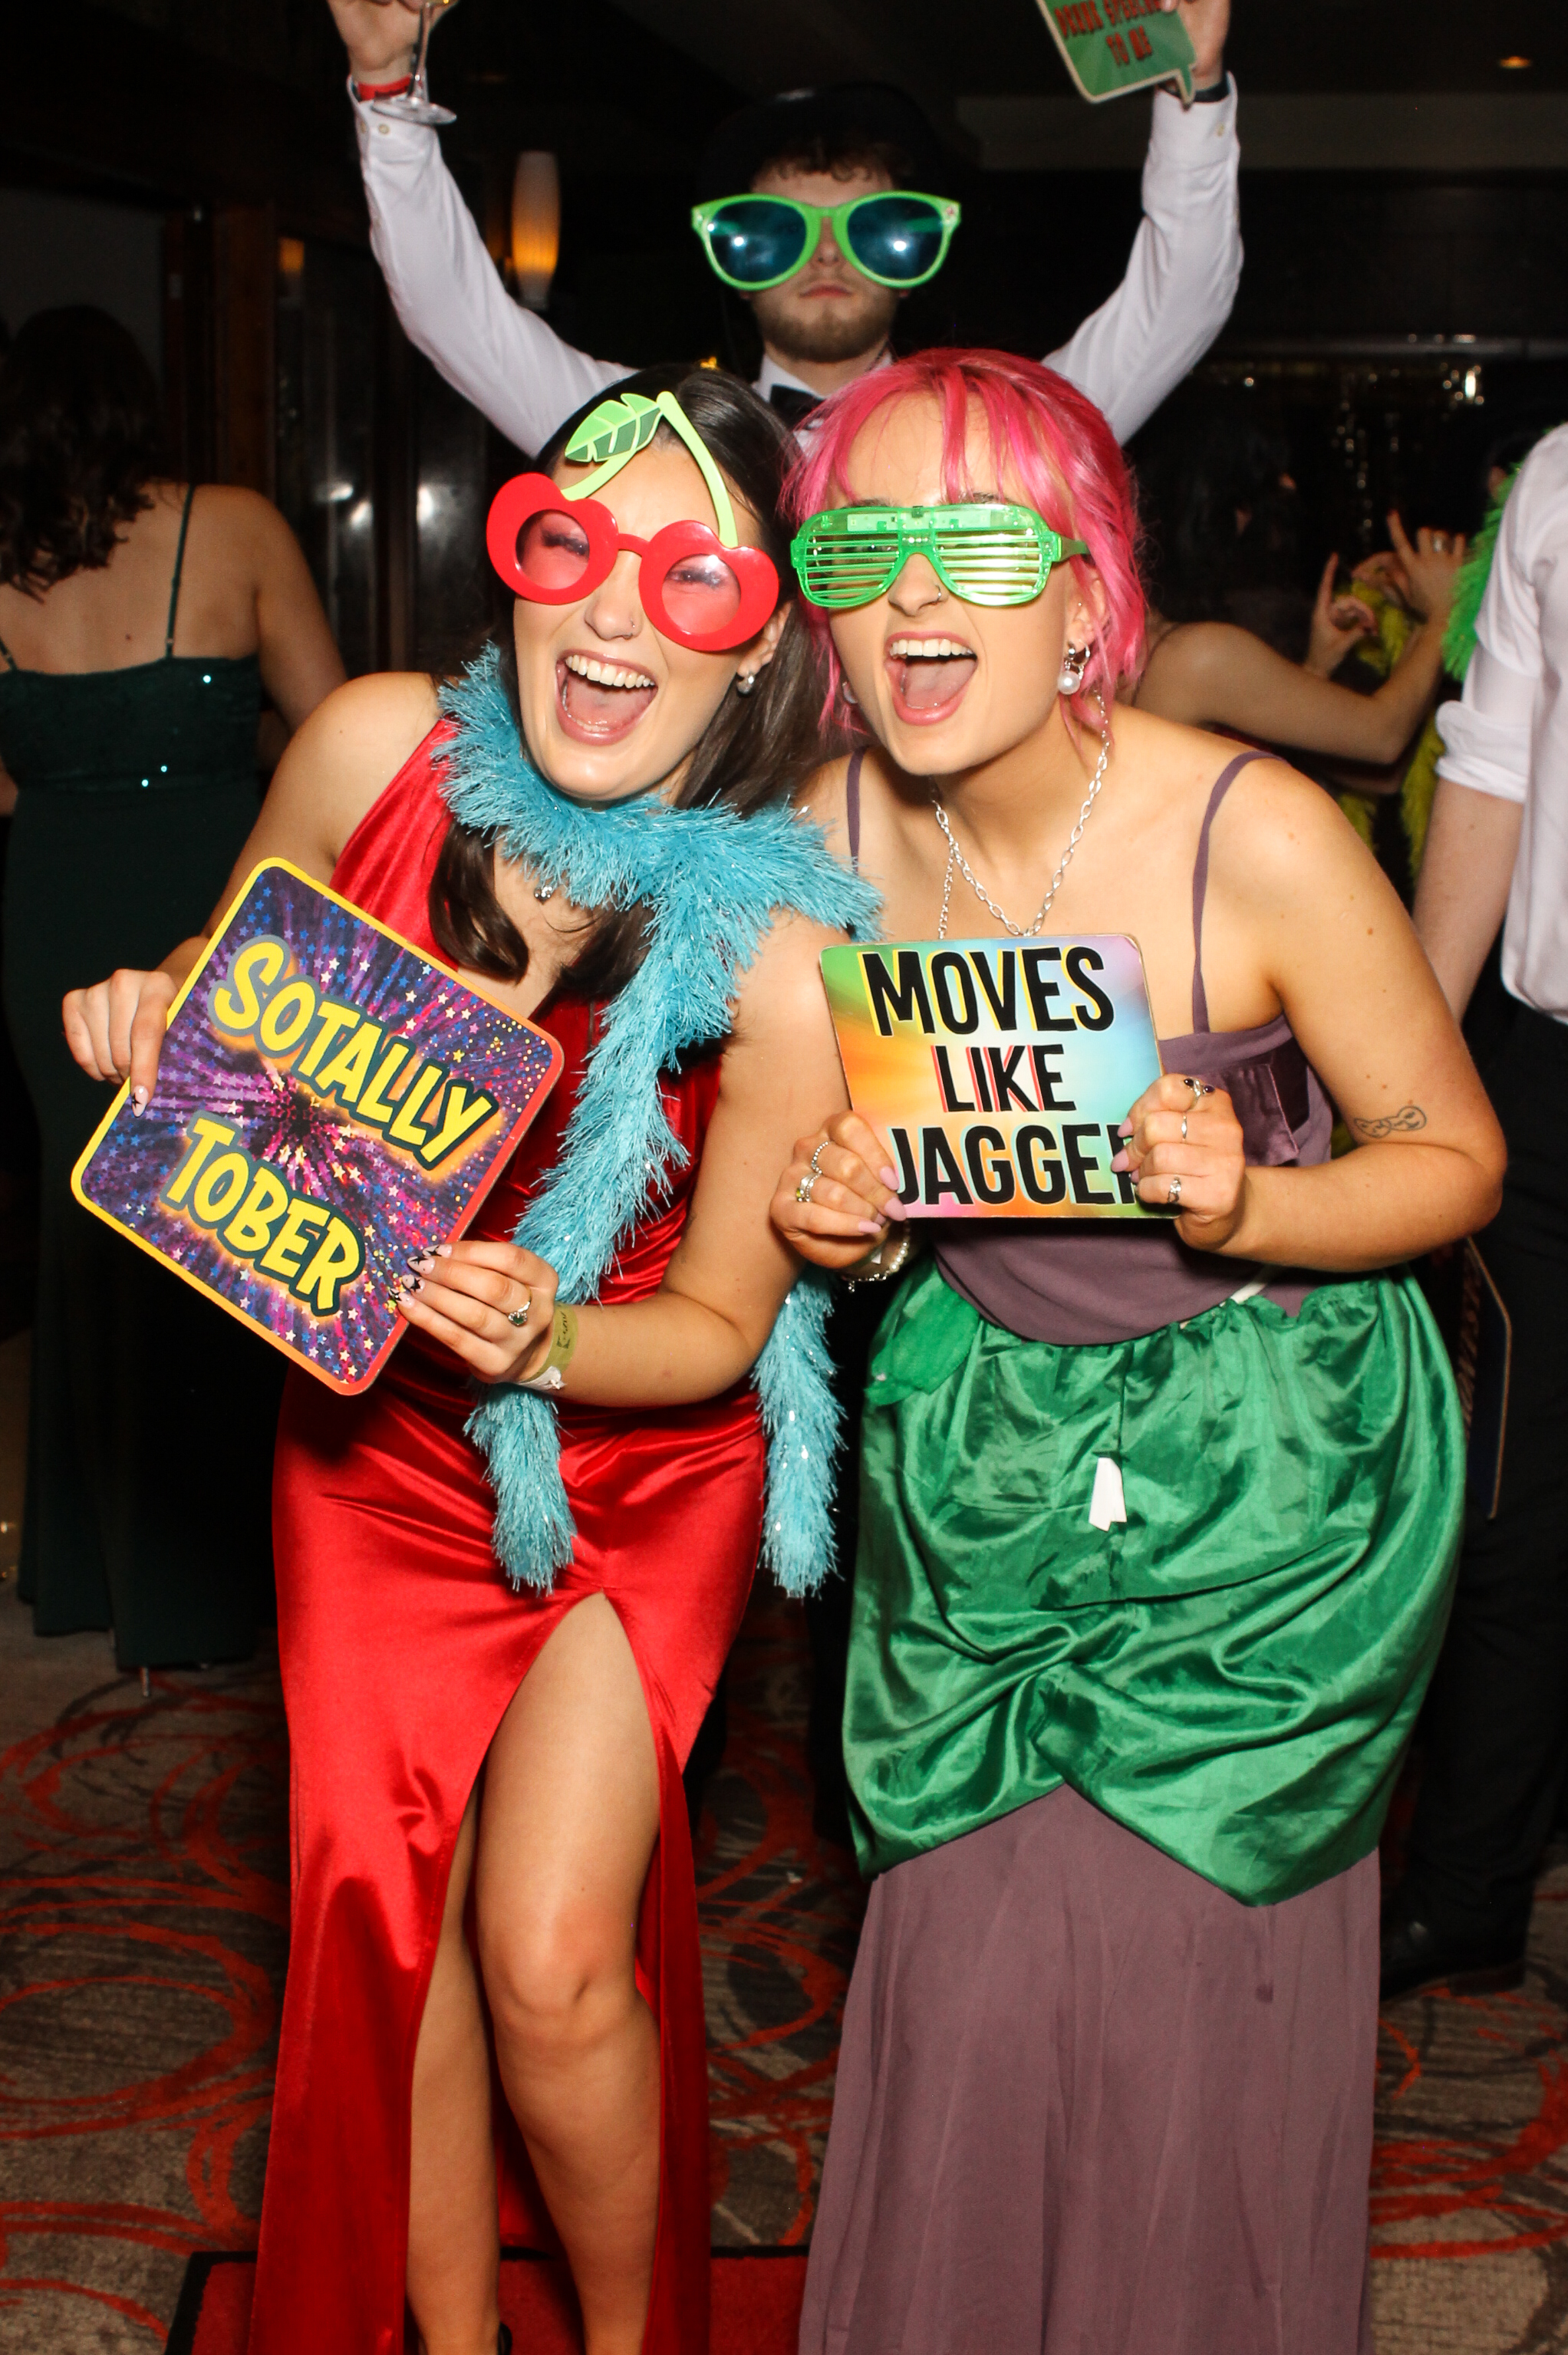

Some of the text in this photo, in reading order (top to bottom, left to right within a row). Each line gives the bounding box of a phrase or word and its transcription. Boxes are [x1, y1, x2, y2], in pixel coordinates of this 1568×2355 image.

[212, 937, 496, 1167] SOTALLY
[858, 947, 1115, 1036] MOVES
[931, 1044, 1076, 1112] LIKE
[163, 1114, 363, 1313] TOBER
